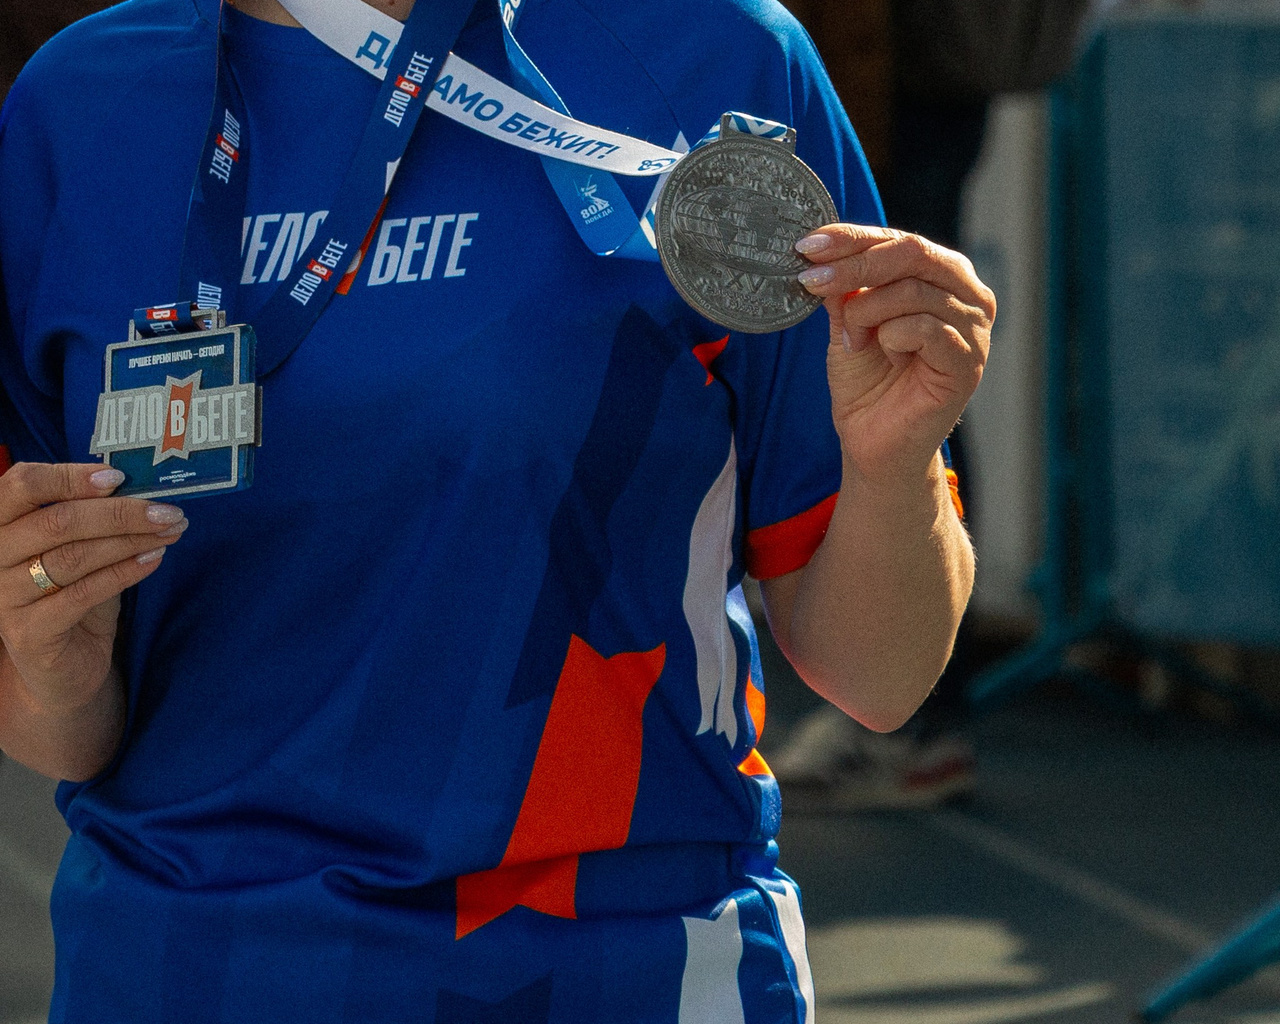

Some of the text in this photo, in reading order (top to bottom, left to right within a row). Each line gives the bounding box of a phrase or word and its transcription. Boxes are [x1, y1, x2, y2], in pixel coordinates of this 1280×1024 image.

[384, 51, 434, 128] ДЕЛО В БЕГЕ
[209, 108, 240, 184] ДЕЛО В БЕГЕ
[498, 111, 622, 160] БЕЖИТ!
[580, 204, 597, 220] 80
[584, 207, 615, 225] ПОБЕДА!
[290, 238, 348, 306] ДЕЛО В БЕГЕ
[367, 212, 480, 287] БЕГЕ
[197, 281, 222, 310] ДЕЛО
[128, 356, 152, 369] ЛУЧШЕЕ
[152, 352, 172, 365] ВРЕМЯ
[171, 349, 193, 362] НАЧАТЬ
[199, 344, 225, 358] СЕГОДНЯ
[97, 390, 248, 447] ДЕЛО В БЕГЕ
